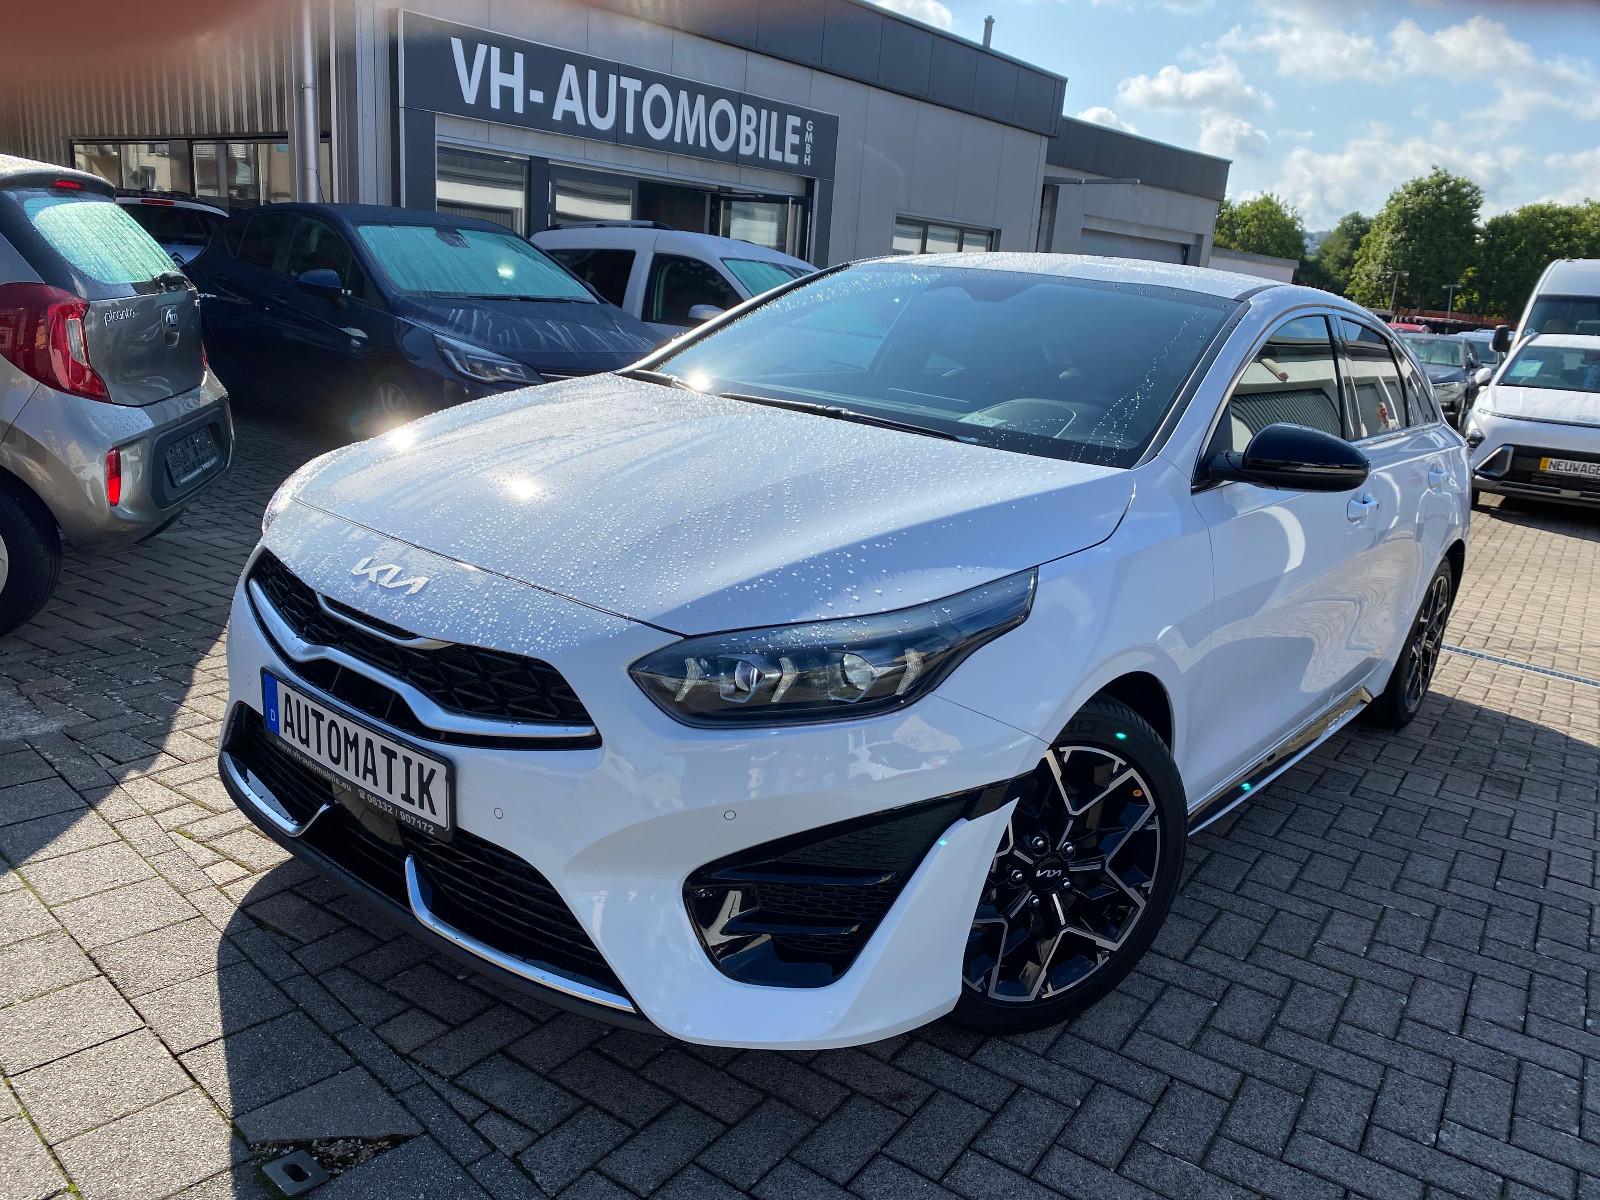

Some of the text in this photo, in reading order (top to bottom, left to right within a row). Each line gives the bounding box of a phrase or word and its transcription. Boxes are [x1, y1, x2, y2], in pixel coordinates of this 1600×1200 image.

[803, 120, 814, 166] GMBH
[350, 556, 430, 596] KIA
[283, 692, 437, 816] AUTOMATIK
[399, 810, 435, 835] 907172
